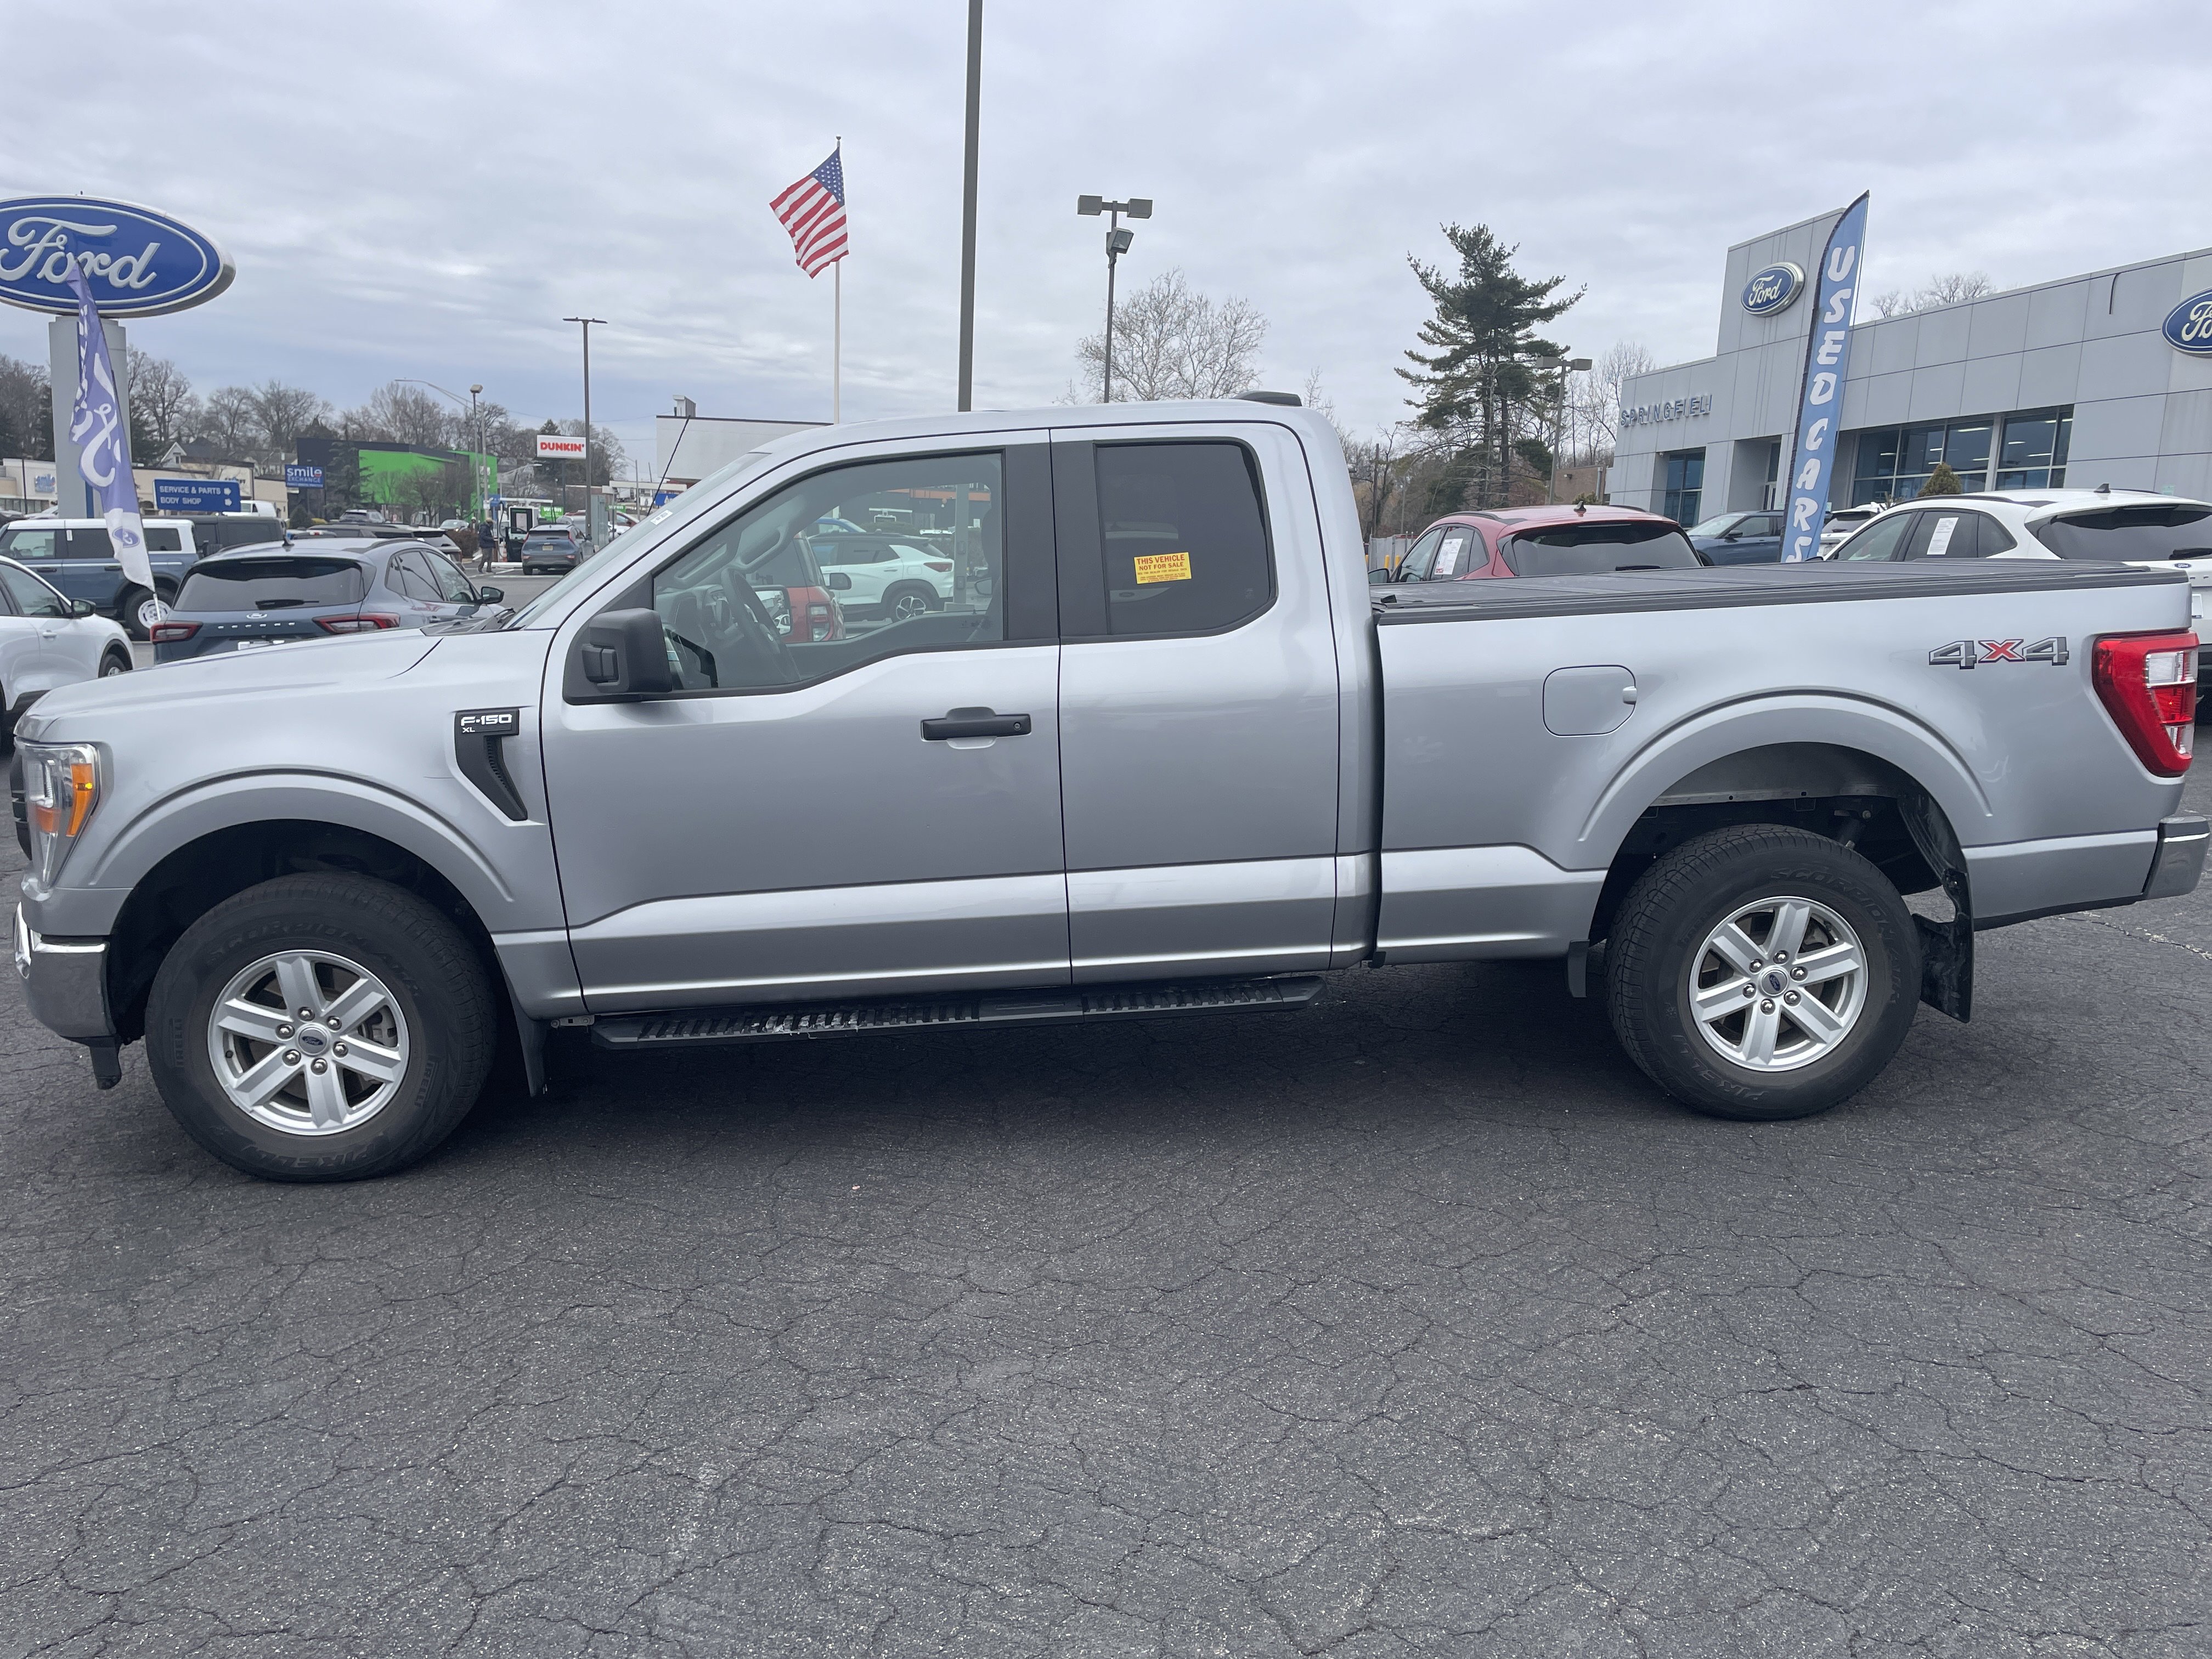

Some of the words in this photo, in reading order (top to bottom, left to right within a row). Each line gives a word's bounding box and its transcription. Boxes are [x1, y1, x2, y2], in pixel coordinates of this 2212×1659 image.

[0, 216, 160, 290] Ford
[1748, 274, 1782, 307] Ford
[1810, 245, 1855, 405] USED
[2181, 301, 2212, 342] Fo
[540, 442, 584, 452] DUNKIN'
[287, 466, 322, 478] smile
[159, 486, 189, 494] SERVICE
[198, 487, 221, 495] PARTS
[1785, 417, 1827, 562] CARS
[1155, 554, 1185, 563] VEHICLE
[461, 714, 512, 726] F-150
